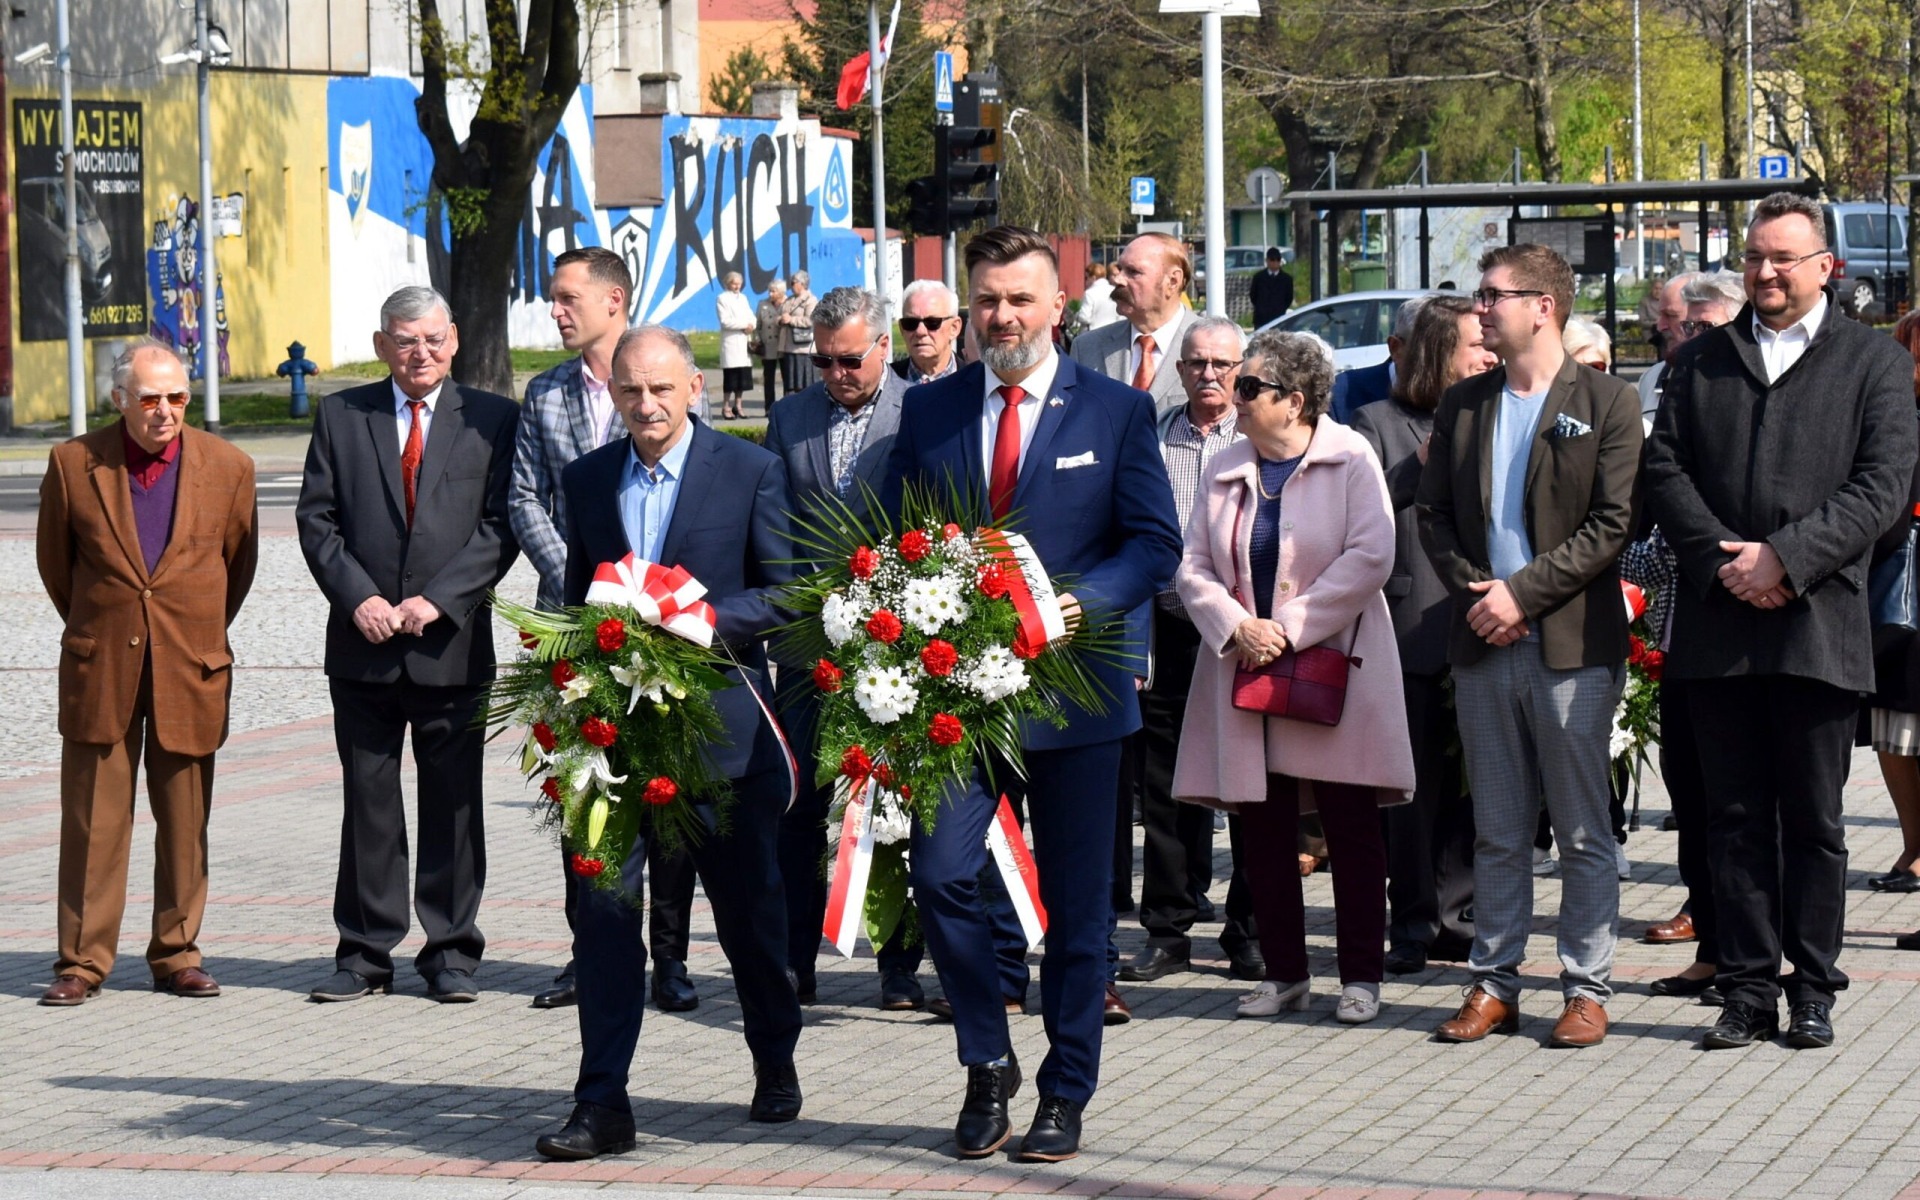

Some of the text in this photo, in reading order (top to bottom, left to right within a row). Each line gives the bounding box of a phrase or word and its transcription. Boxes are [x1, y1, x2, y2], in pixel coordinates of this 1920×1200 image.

[56, 147, 139, 173] SMOCHODÓW
[1766, 159, 1782, 178] P
[1136, 181, 1150, 201] P
[669, 132, 814, 299] RUCH
[90, 304, 143, 324] 661 927 295
